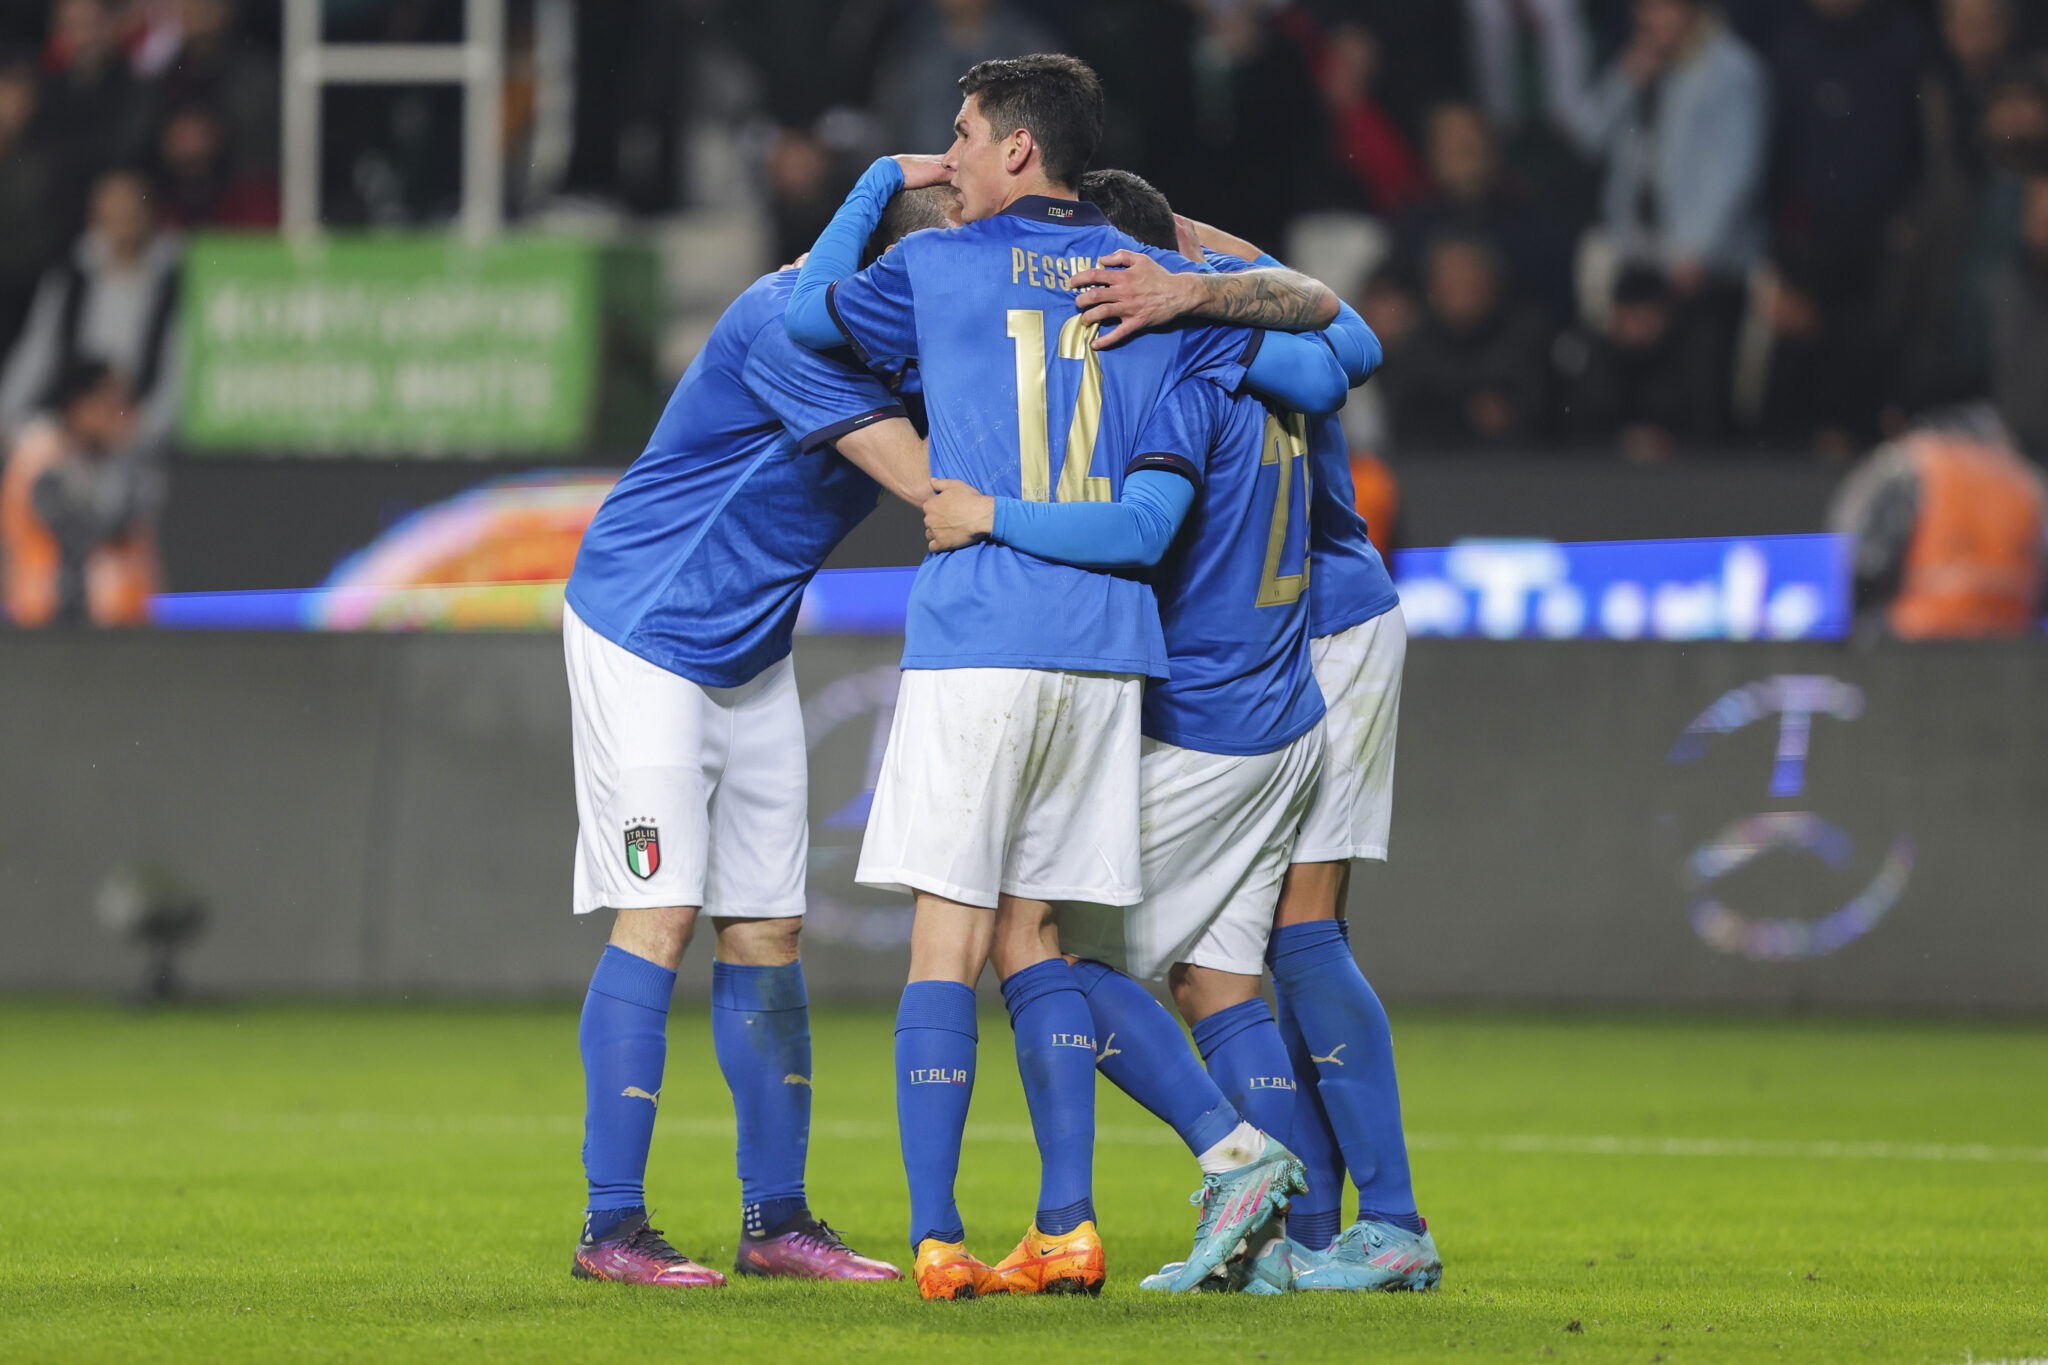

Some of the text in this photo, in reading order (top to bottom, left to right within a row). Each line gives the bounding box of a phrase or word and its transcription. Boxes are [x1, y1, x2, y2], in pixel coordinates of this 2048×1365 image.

[1048, 206, 1074, 216] ITALIA
[1011, 247, 1106, 293] PESSIN
[1006, 309, 1111, 502] 12
[626, 830, 656, 841] ITALIA
[910, 1068, 967, 1083] ITALIA
